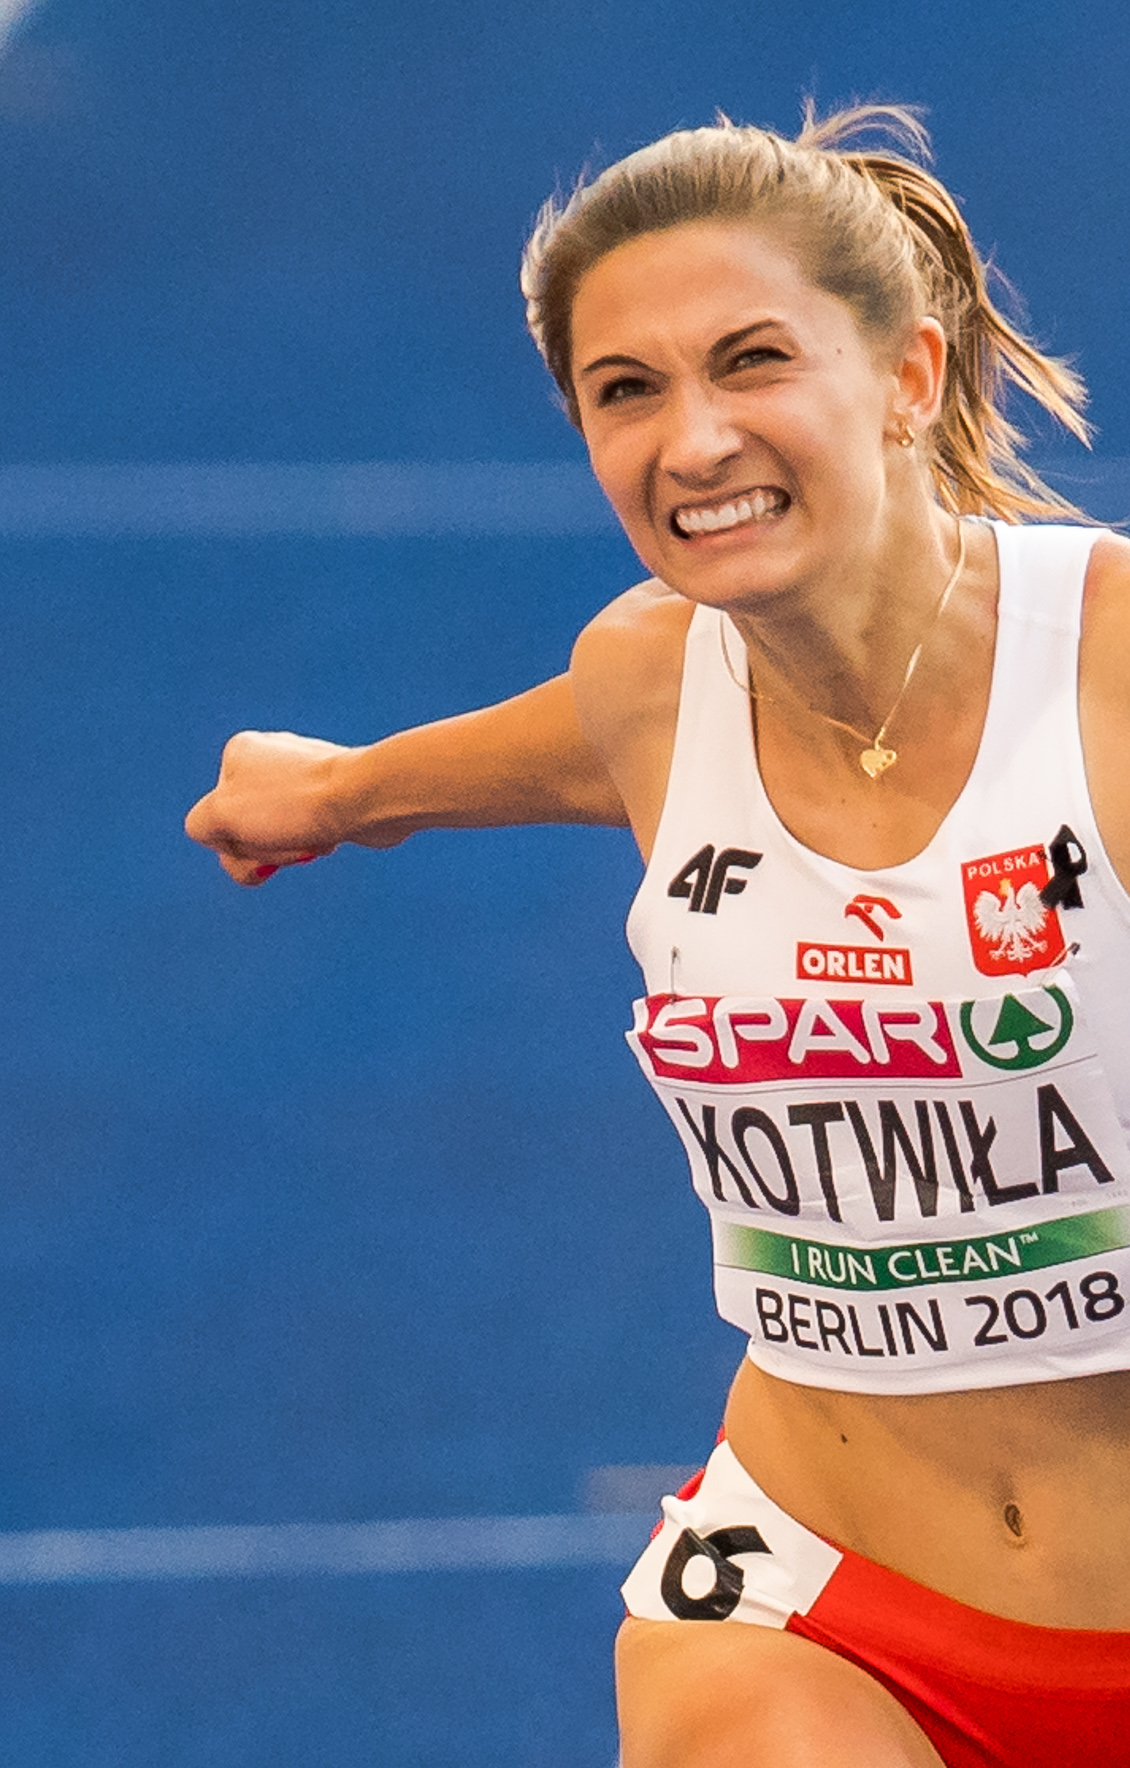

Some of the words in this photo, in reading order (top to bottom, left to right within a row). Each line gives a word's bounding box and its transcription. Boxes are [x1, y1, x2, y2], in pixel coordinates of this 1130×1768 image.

[668, 843, 763, 914] 4F
[967, 852, 1041, 880] POLSKA
[802, 948, 905, 980] ORLEN
[650, 996, 948, 1068] SPAR
[675, 1083, 1115, 1222] KOTWIŁA
[791, 1243, 800, 1275] I
[807, 1246, 877, 1285] RUN
[756, 1287, 948, 1358] BERLIN
[965, 1271, 1125, 1347] 2018
[661, 1525, 774, 1621] 6
